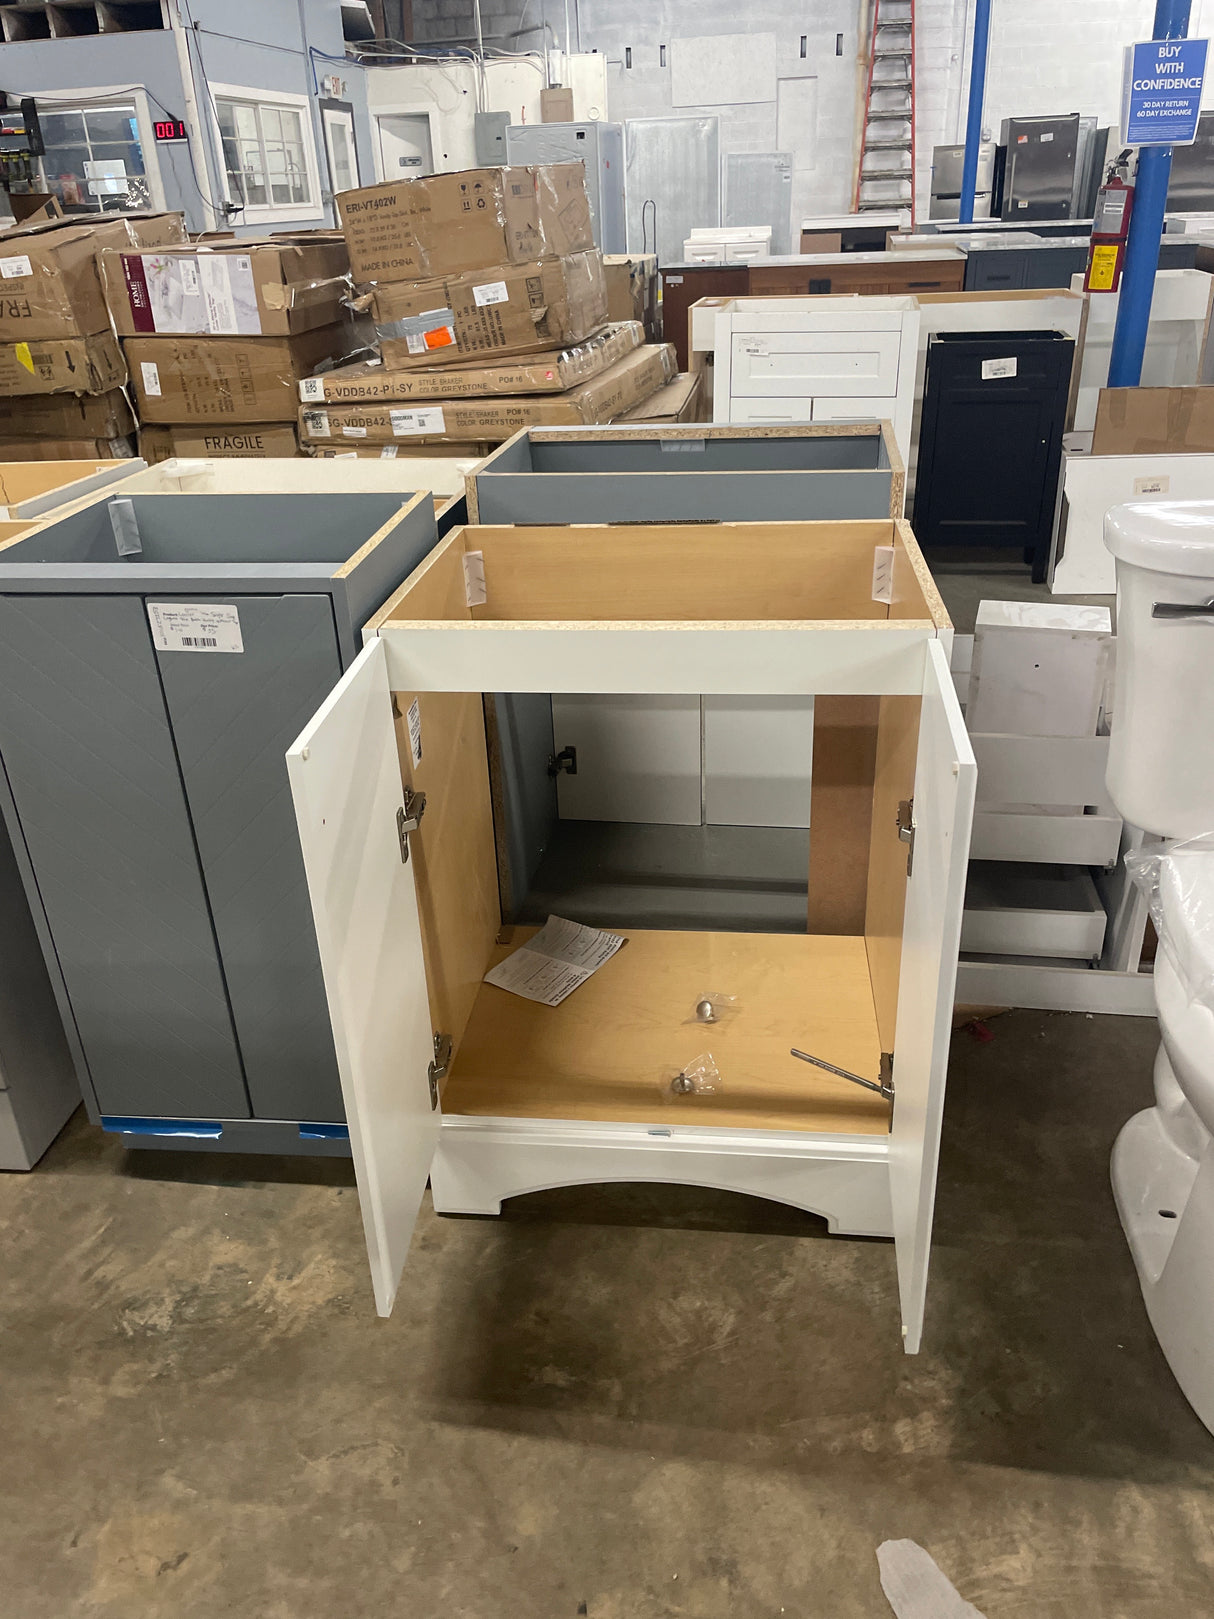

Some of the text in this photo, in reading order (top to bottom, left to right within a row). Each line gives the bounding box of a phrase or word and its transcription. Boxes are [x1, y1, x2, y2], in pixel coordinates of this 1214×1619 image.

[1158, 46, 1182, 58] BUY
[1155, 62, 1185, 74] WITH
[1133, 77, 1202, 91] CONFIDENCE
[1160, 108, 1192, 117] EXCHANGE
[361, 258, 414, 273] MADE IN CHINA
[130, 280, 141, 308] HOME
[439, 377, 463, 385] SHAKER
[499, 376, 514, 384] PO#
[441, 383, 488, 392] GREYSTONE
[455, 411, 473, 419] STYLE
[475, 410, 499, 418] SHAKER
[479, 418, 525, 426] GREYSTONE
[204, 436, 264, 450] FRAGILE
